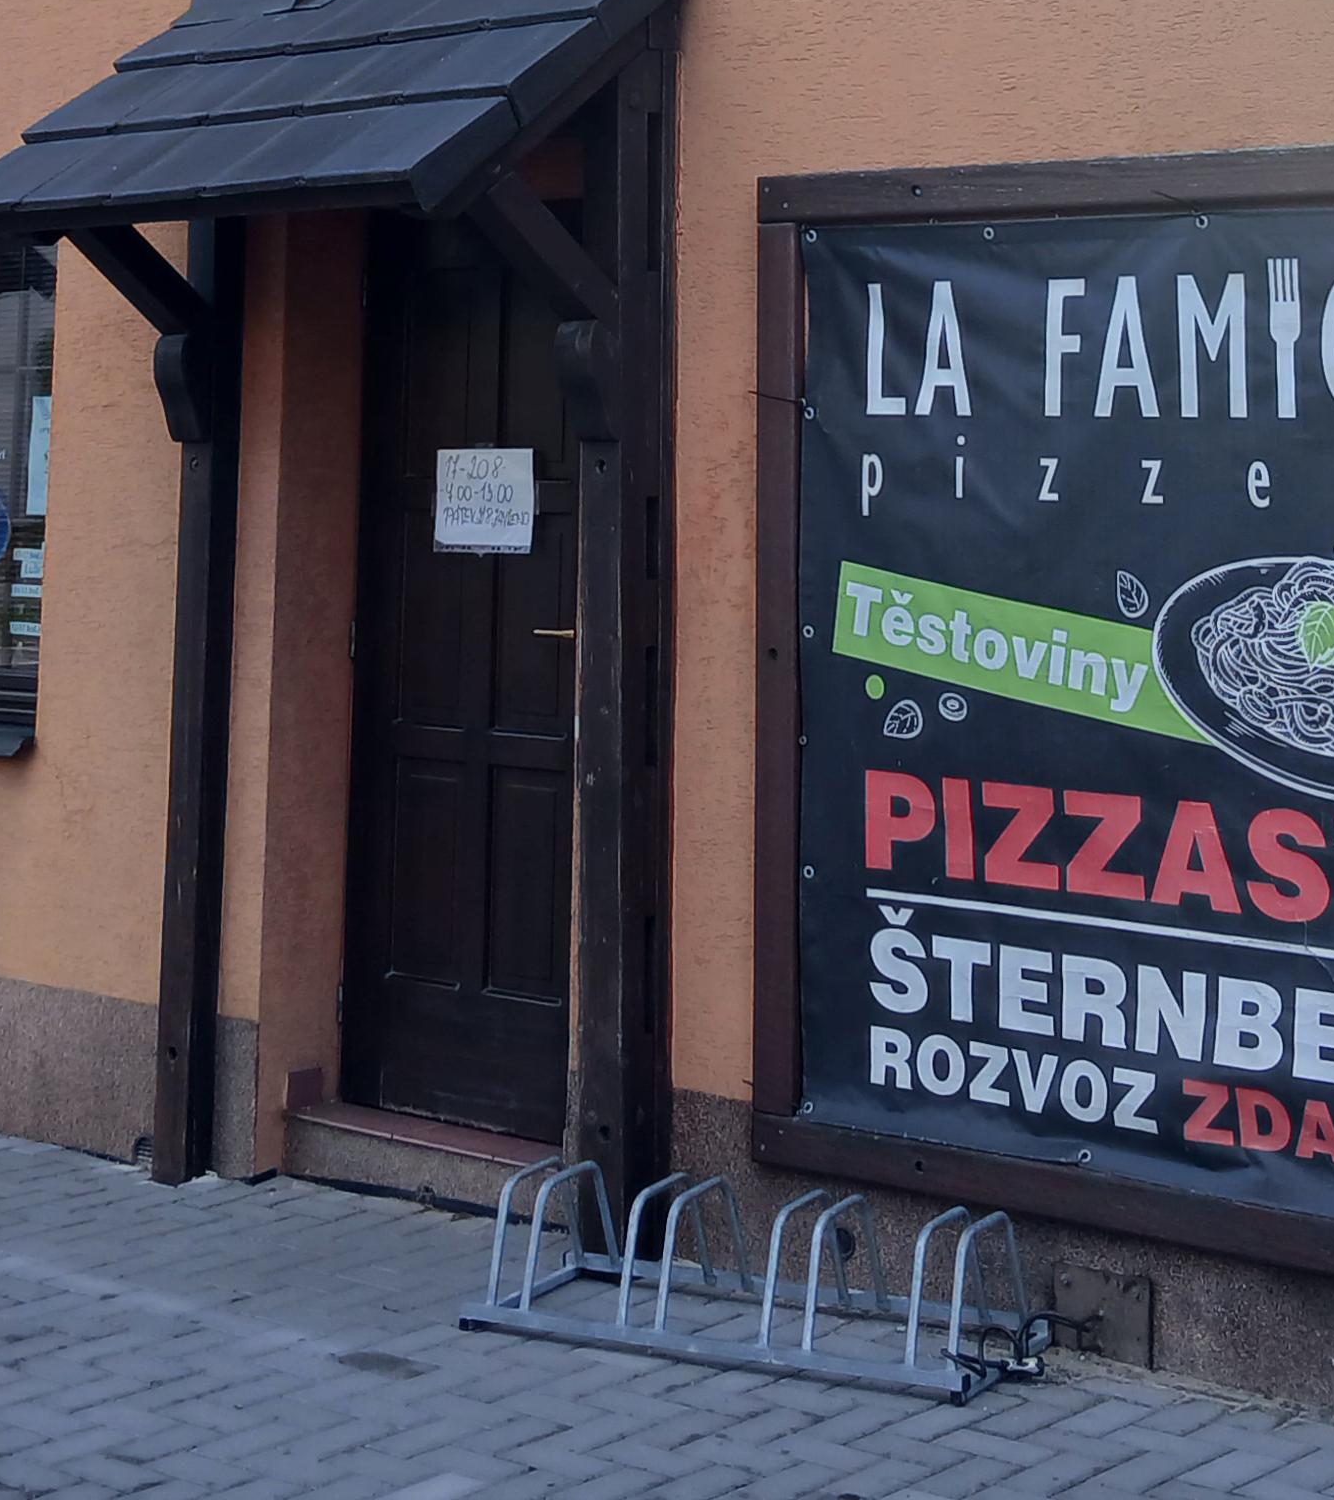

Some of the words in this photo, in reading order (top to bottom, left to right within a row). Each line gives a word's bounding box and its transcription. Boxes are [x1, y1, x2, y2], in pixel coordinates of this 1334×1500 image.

[867, 280, 971, 417] LA
[844, 581, 1149, 711] Těstoviny
[869, 1024, 1159, 1134] ROZVOZ
